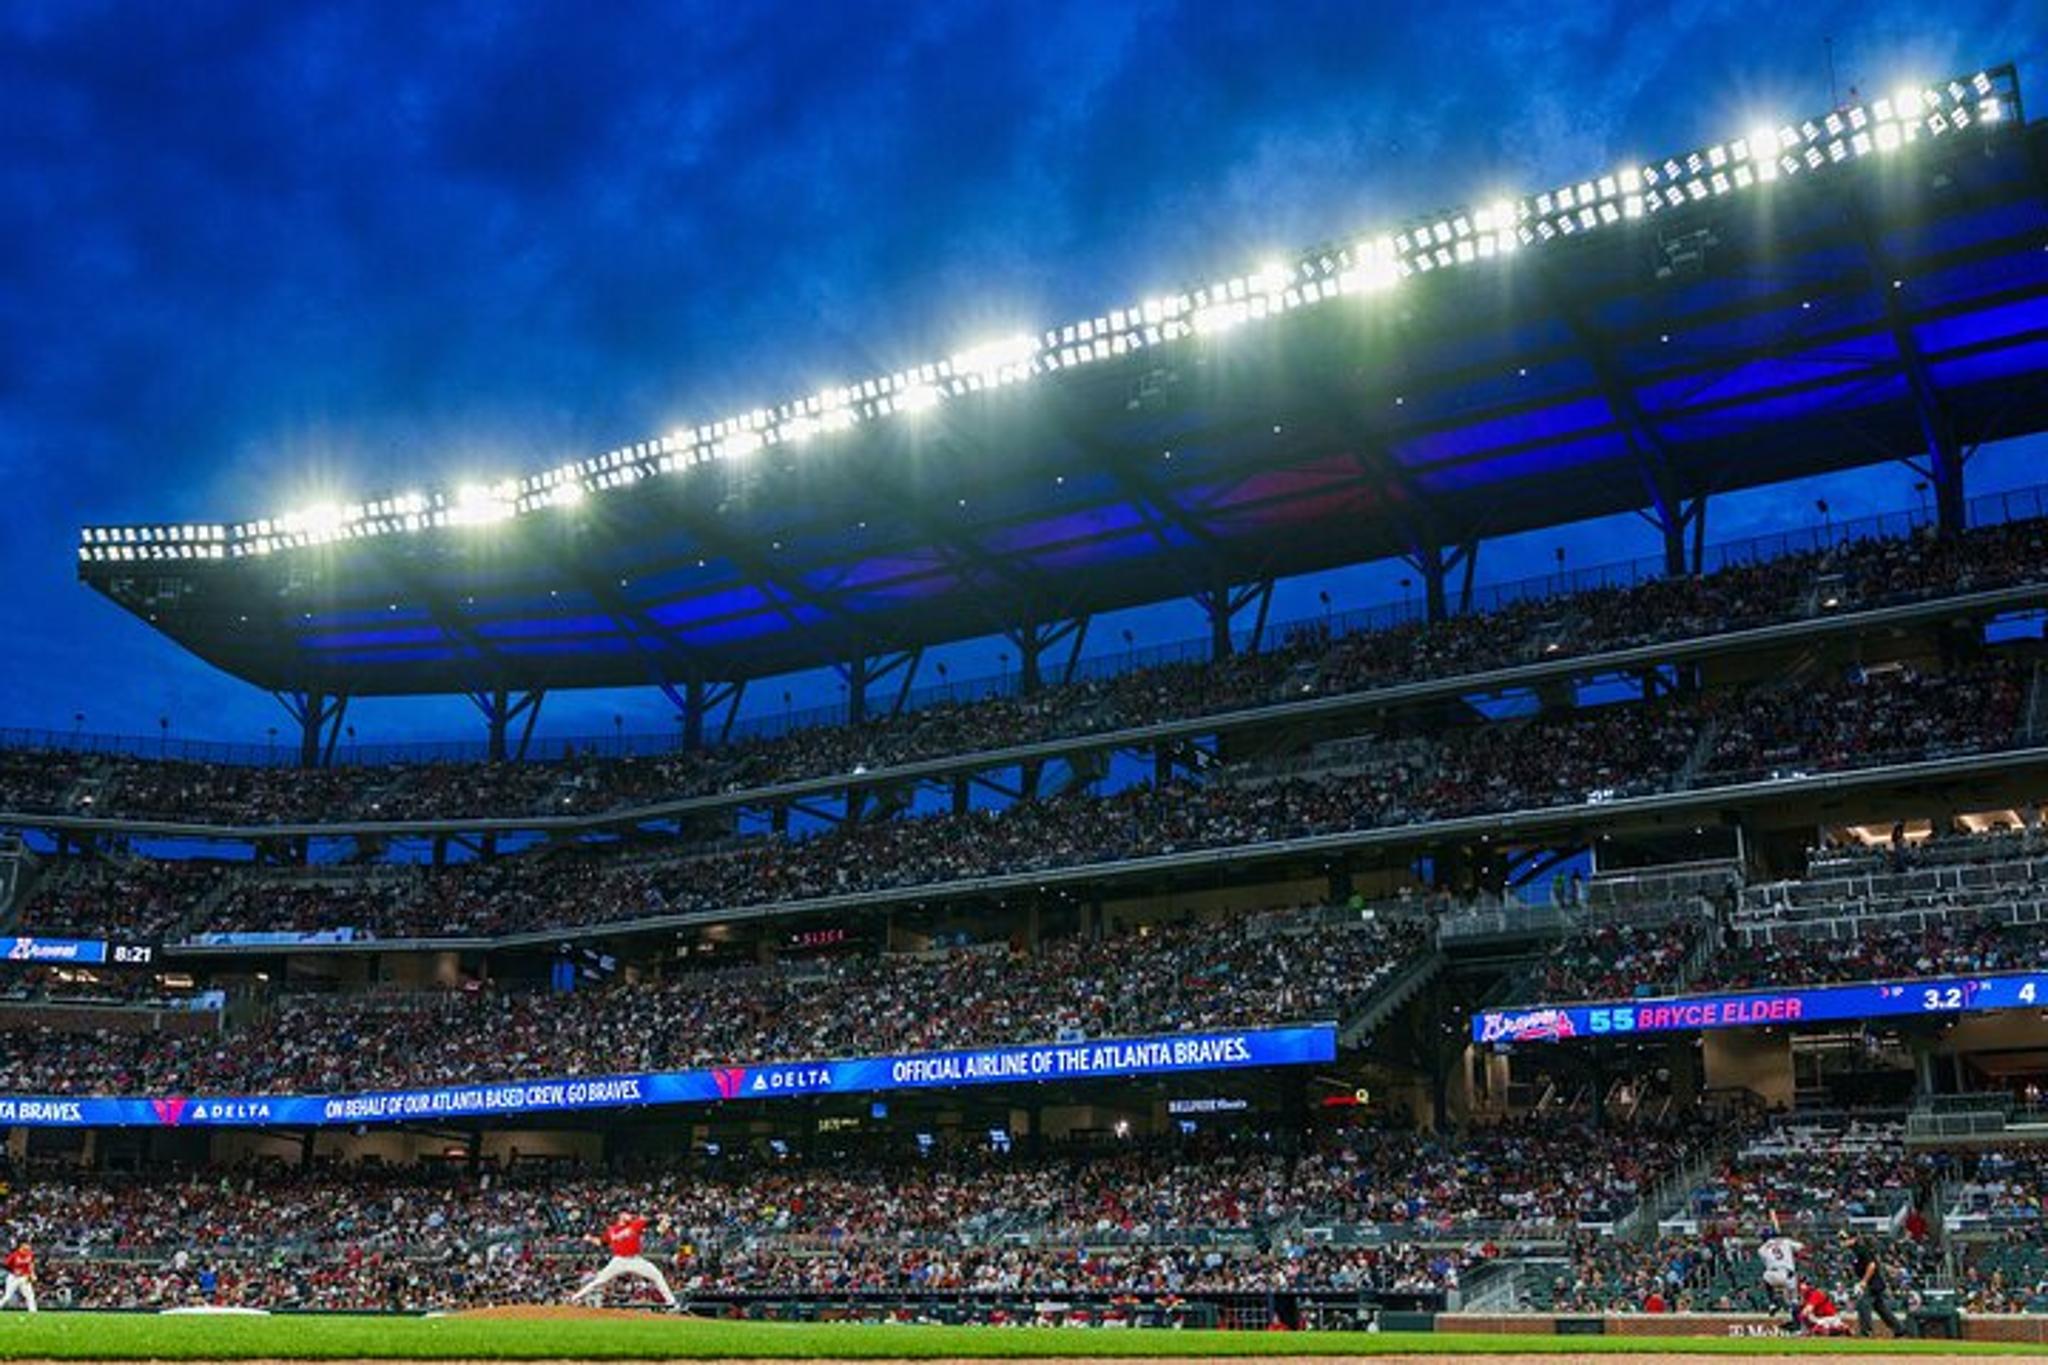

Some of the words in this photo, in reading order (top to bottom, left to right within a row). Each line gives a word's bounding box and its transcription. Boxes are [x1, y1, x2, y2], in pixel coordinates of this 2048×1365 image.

[114, 946, 151, 962] 8:21
[1922, 988, 1961, 1010] 3.2
[2018, 983, 2036, 1004] 4
[1590, 1008, 1634, 1033] 55
[1638, 1003, 1717, 1030] BRYCE
[1723, 998, 1803, 1022] ELDER
[892, 1057, 962, 1082] OFFICIAL
[964, 1054, 1029, 1078] AIRLINE
[1031, 1050, 1054, 1073] OF
[1056, 1048, 1090, 1071] THE
[1092, 1042, 1172, 1069] ATLANTA
[1174, 1037, 1251, 1065] BRAVES.
[770, 1070, 831, 1088] DELTA
[325, 1099, 343, 1119] ON
[344, 1096, 387, 1116] BEHALF
[387, 1095, 404, 1115] OF
[404, 1093, 429, 1113] OUR
[431, 1090, 485, 1111] ATLANTA
[485, 1087, 525, 1109] BASED
[567, 1082, 587, 1104] GO
[588, 1079, 641, 1101] BRAVES.
[19, 1102, 81, 1121] BRAVES.
[211, 1103, 270, 1117] DELTA
